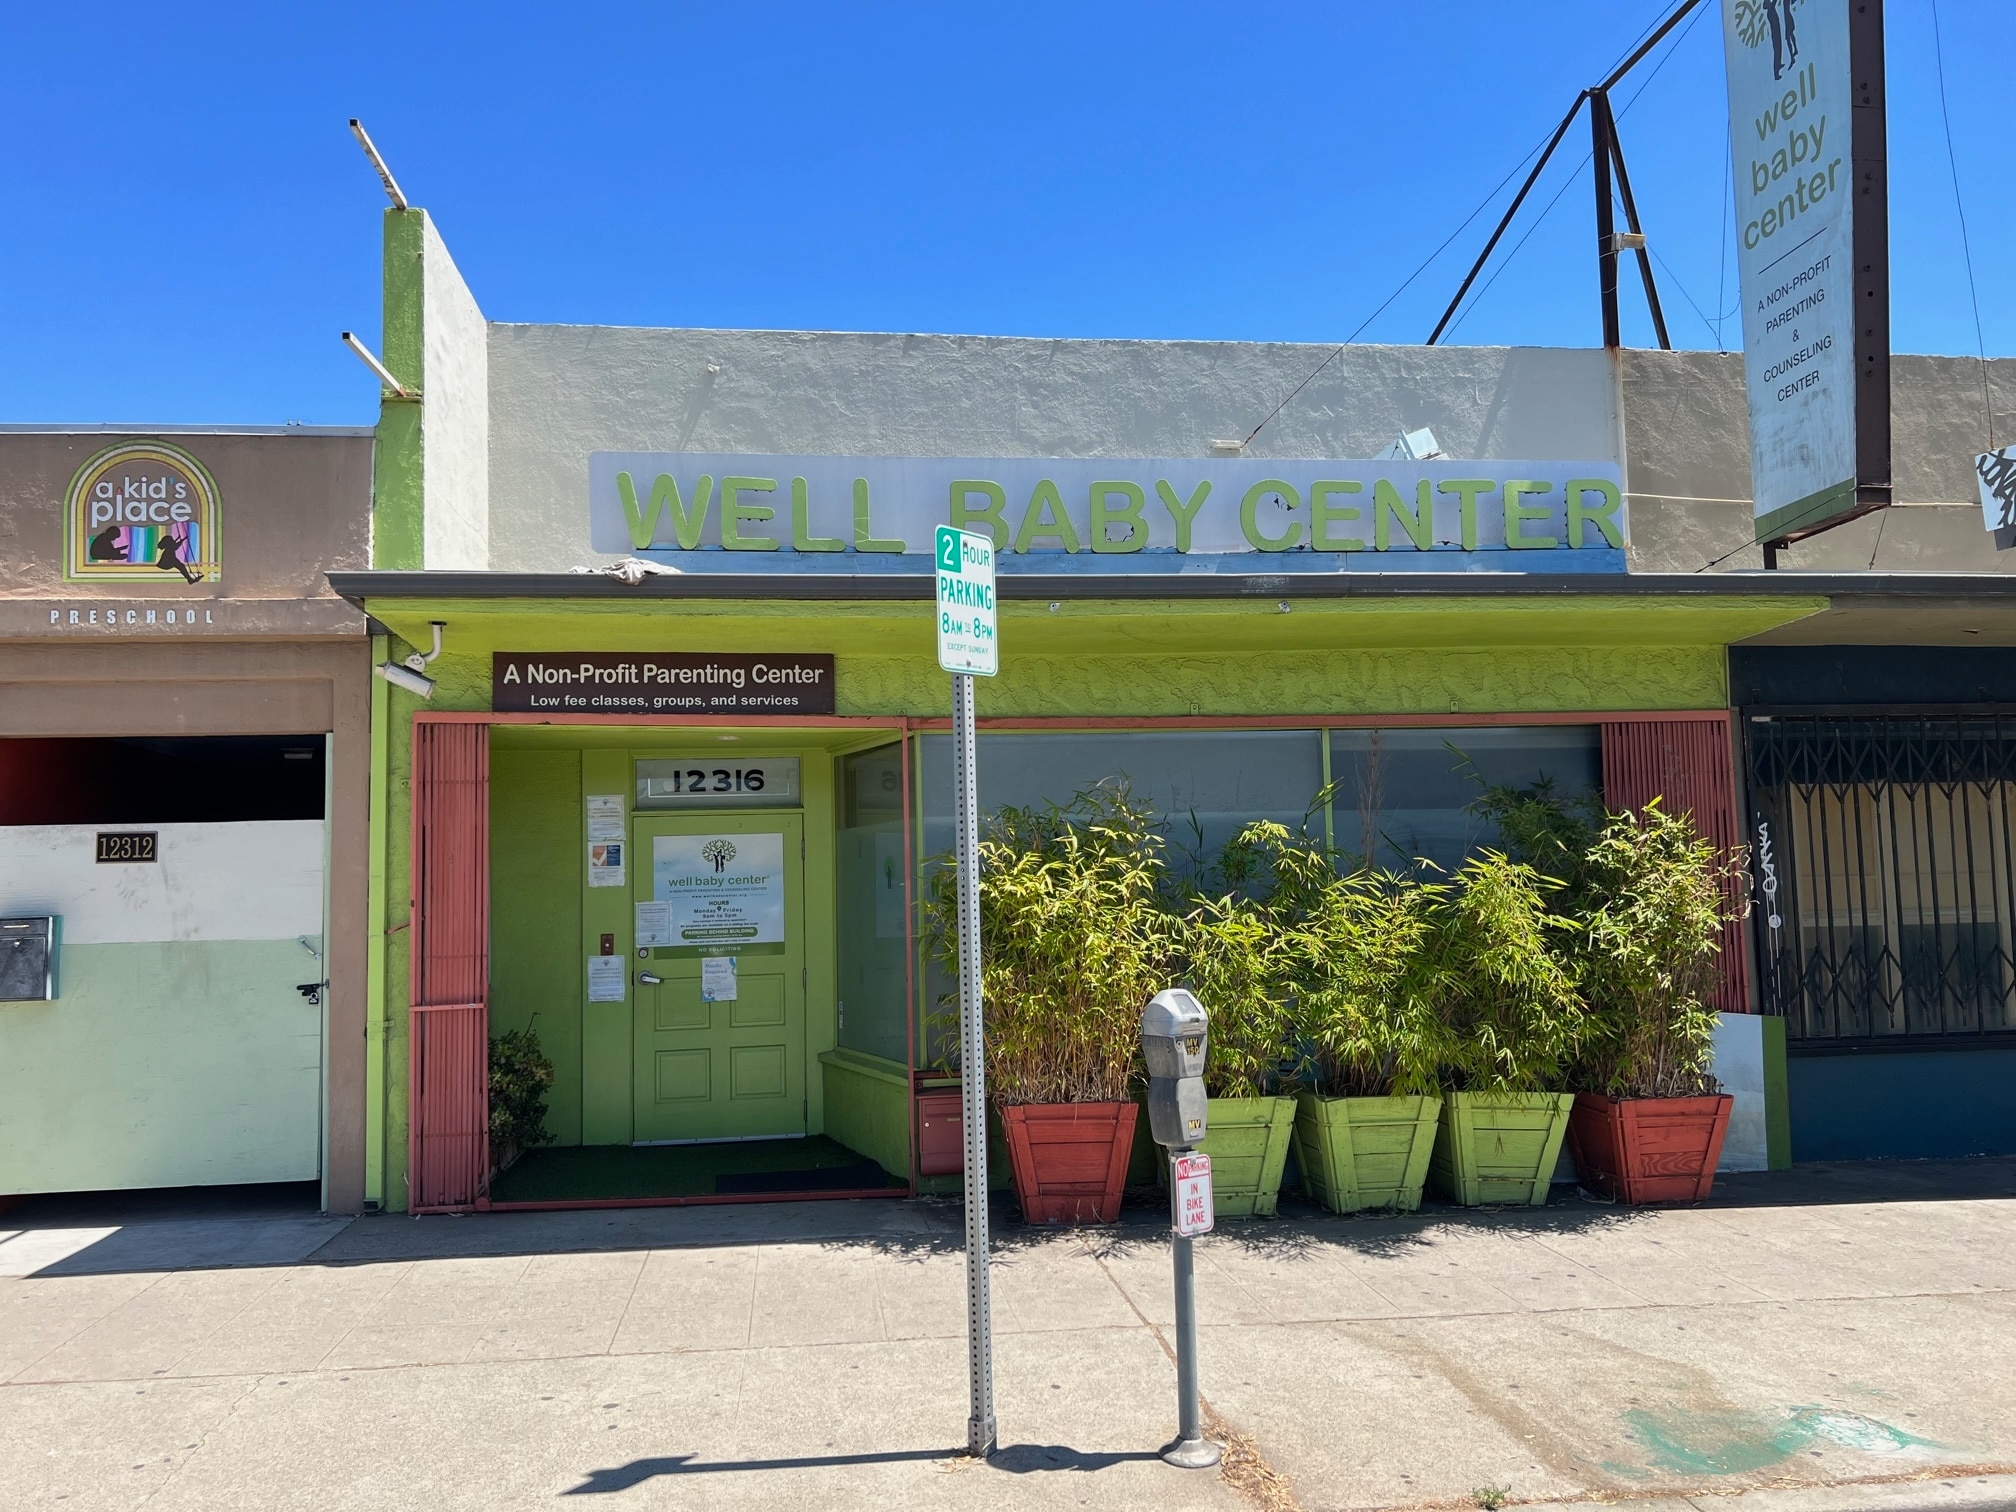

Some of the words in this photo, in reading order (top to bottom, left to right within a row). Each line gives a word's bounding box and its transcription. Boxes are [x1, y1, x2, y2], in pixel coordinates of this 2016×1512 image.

[1754, 62, 1816, 142] well
[1752, 114, 1826, 196] baby
[1743, 157, 1842, 250] center
[1757, 300, 1765, 313] A
[1766, 255, 1832, 310] NON-PROFIT
[1765, 288, 1826, 335] PARENTING
[1792, 329, 1800, 343] &
[1763, 334, 1833, 383] COUNSELING
[1777, 370, 1820, 403] CENTER
[95, 481, 113, 499] a
[124, 476, 187, 500] kid's
[91, 492, 192, 528] place
[616, 471, 907, 554] WELL
[950, 478, 1212, 555] BABY
[1239, 478, 1625, 553] CENTER
[942, 534, 955, 566] 2
[963, 541, 990, 567] HOUR
[940, 576, 992, 610] PARKING
[50, 609, 214, 625] PRESCHOOL
[947, 642, 967, 652] EXCEPT
[968, 645, 989, 655] SUNDAY
[503, 664, 521, 684] A
[527, 663, 639, 684] Non-Profit
[643, 663, 745, 688] Parenting
[751, 663, 824, 685] Center
[530, 695, 560, 706] Low
[564, 694, 588, 706] fee
[591, 695, 649, 708] classes,
[653, 696, 706, 709] groups,
[711, 695, 737, 706] and
[741, 696, 799, 707] services
[673, 769, 766, 793] 12316
[98, 836, 154, 860] 12312
[668, 876, 693, 887] well
[695, 876, 725, 888] baby
[727, 874, 767, 885] center
[1186, 1038, 1199, 1047] MV
[1188, 1120, 1201, 1130] MV
[1177, 1162, 1189, 1178] NO
[1190, 1182, 1199, 1196] IN
[1186, 1196, 1204, 1211] BIKE
[1185, 1210, 1206, 1226] LANE
